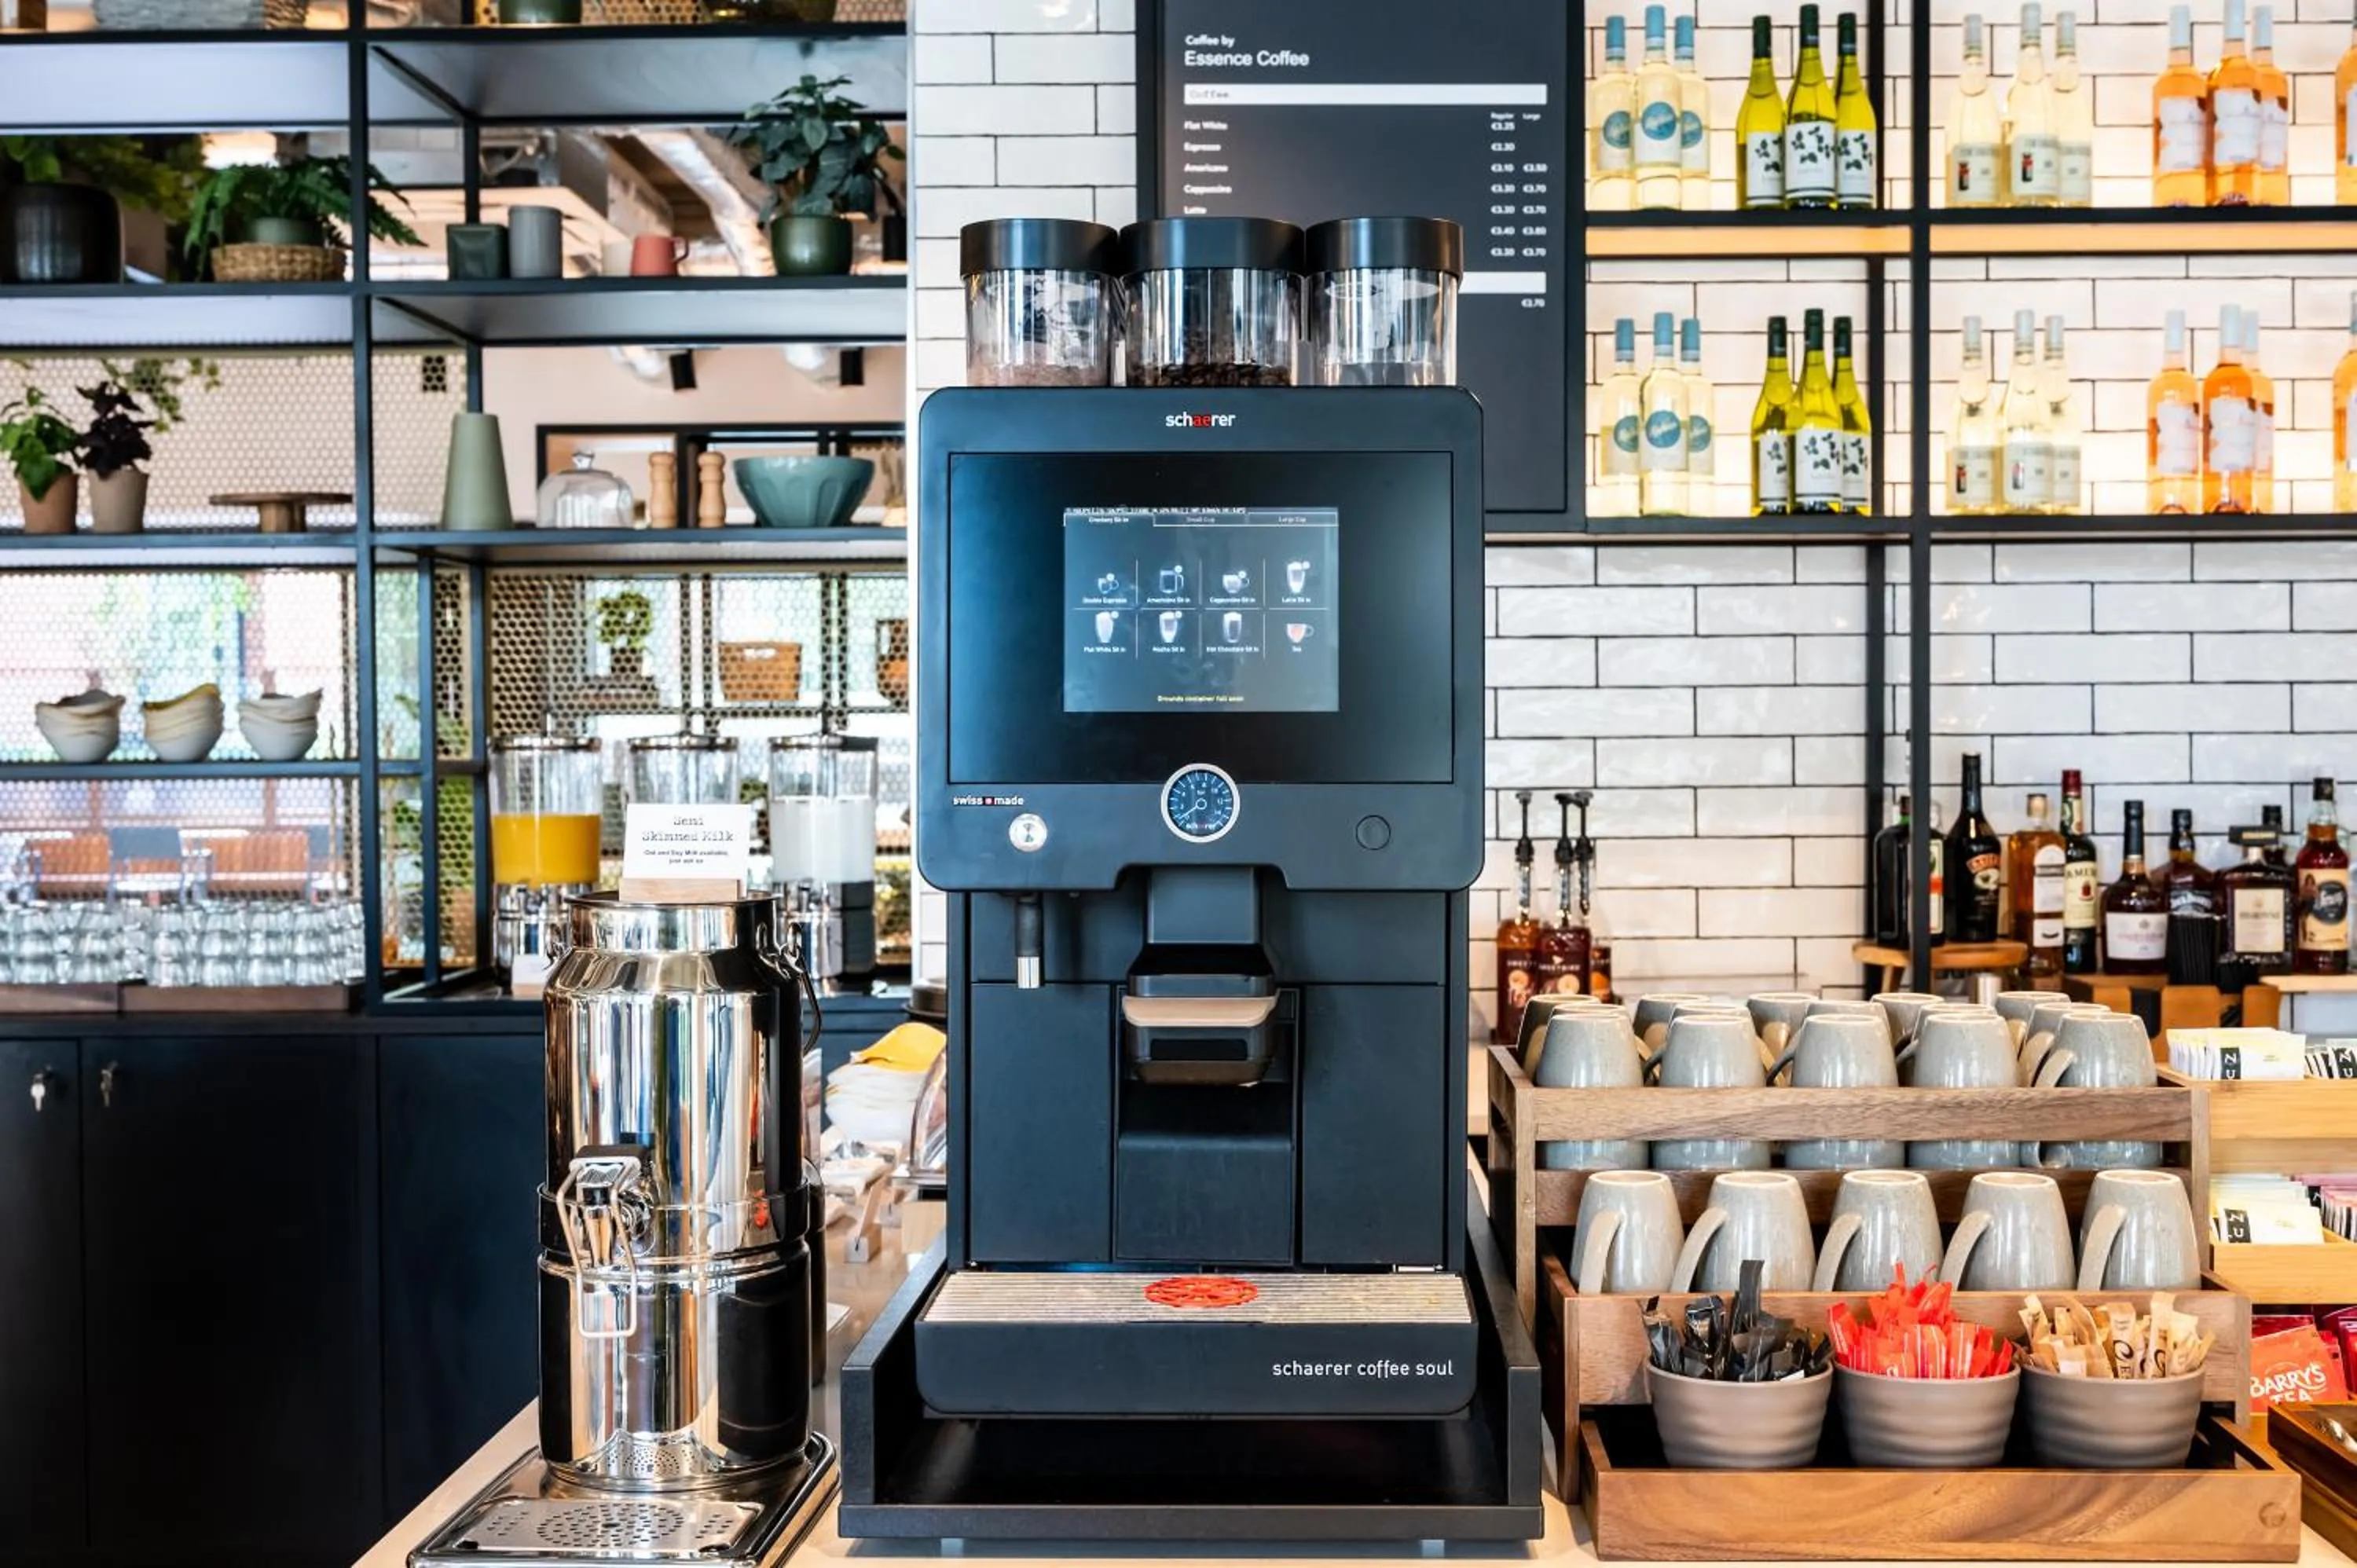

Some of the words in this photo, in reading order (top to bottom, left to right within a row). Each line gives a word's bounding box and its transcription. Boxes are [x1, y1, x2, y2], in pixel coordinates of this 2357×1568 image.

[1185, 35, 1219, 46] Coffee
[1220, 35, 1235, 48] by
[1184, 49, 1253, 67] Essence
[1256, 49, 1310, 67] Coffee
[1201, 120, 1228, 130] White
[1183, 163, 1229, 173] Americano
[1165, 411, 1236, 427] schaerer
[953, 795, 983, 805] swiss
[994, 795, 1025, 805] made
[1272, 1360, 1352, 1376] schaerer
[1357, 1360, 1410, 1379] coffee
[1416, 1359, 1453, 1376] soul
